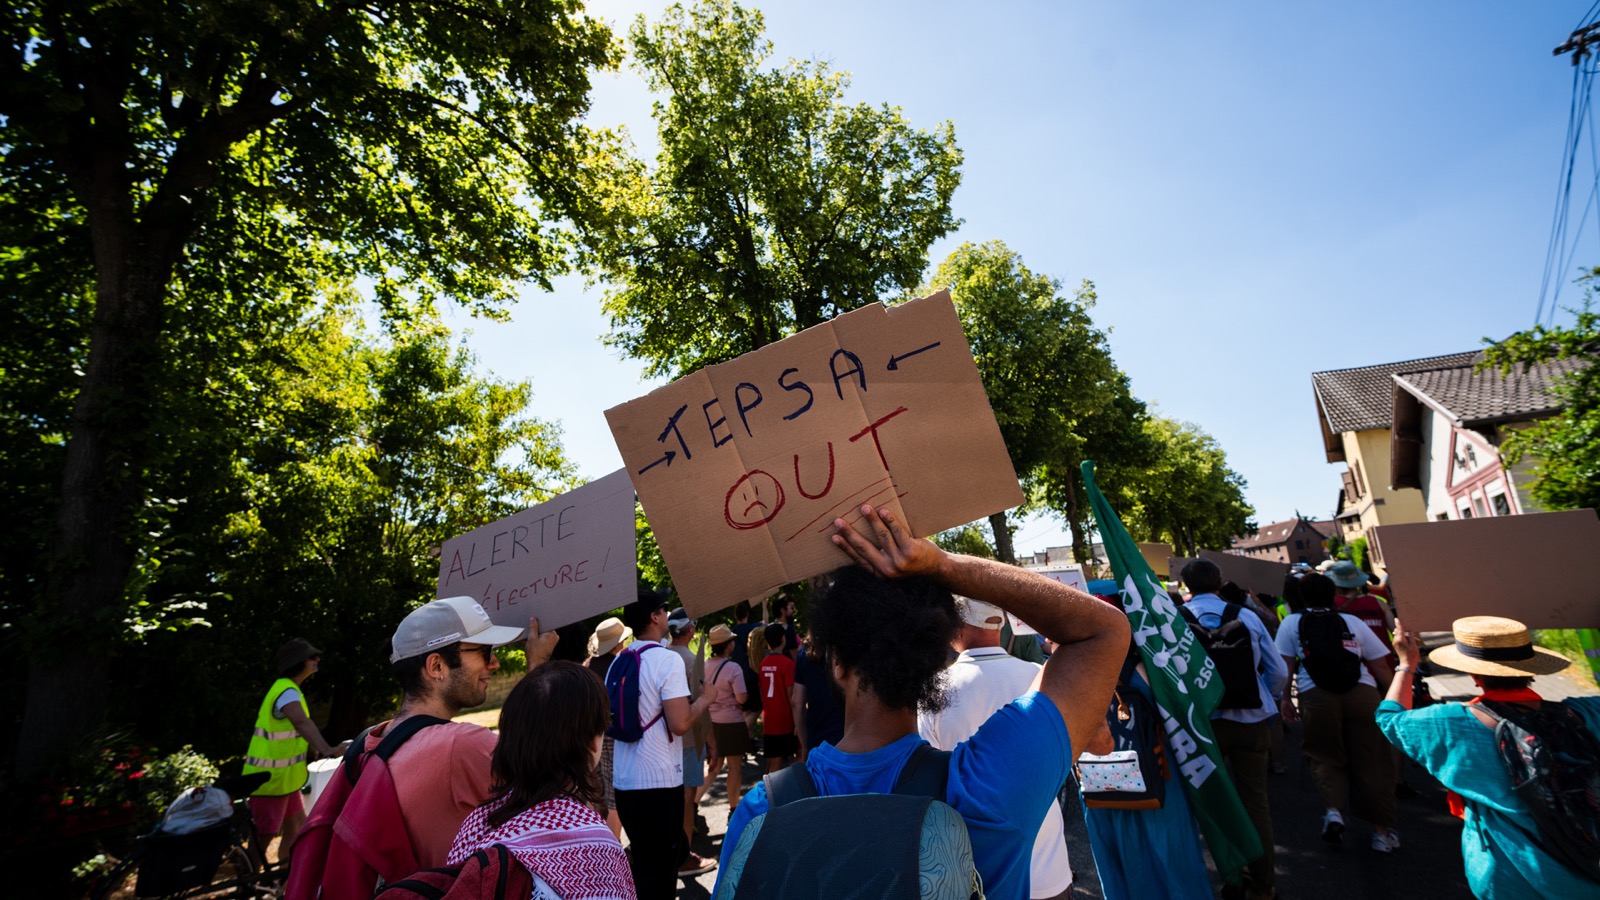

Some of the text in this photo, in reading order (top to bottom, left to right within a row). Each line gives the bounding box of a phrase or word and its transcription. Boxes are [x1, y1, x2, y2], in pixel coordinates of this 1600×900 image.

[657, 348, 867, 460] TEPSA
[724, 405, 908, 530] OUT
[445, 505, 576, 587] ALERTE
[481, 559, 589, 611] ÉFECTURE
[764, 672, 775, 698] 7
